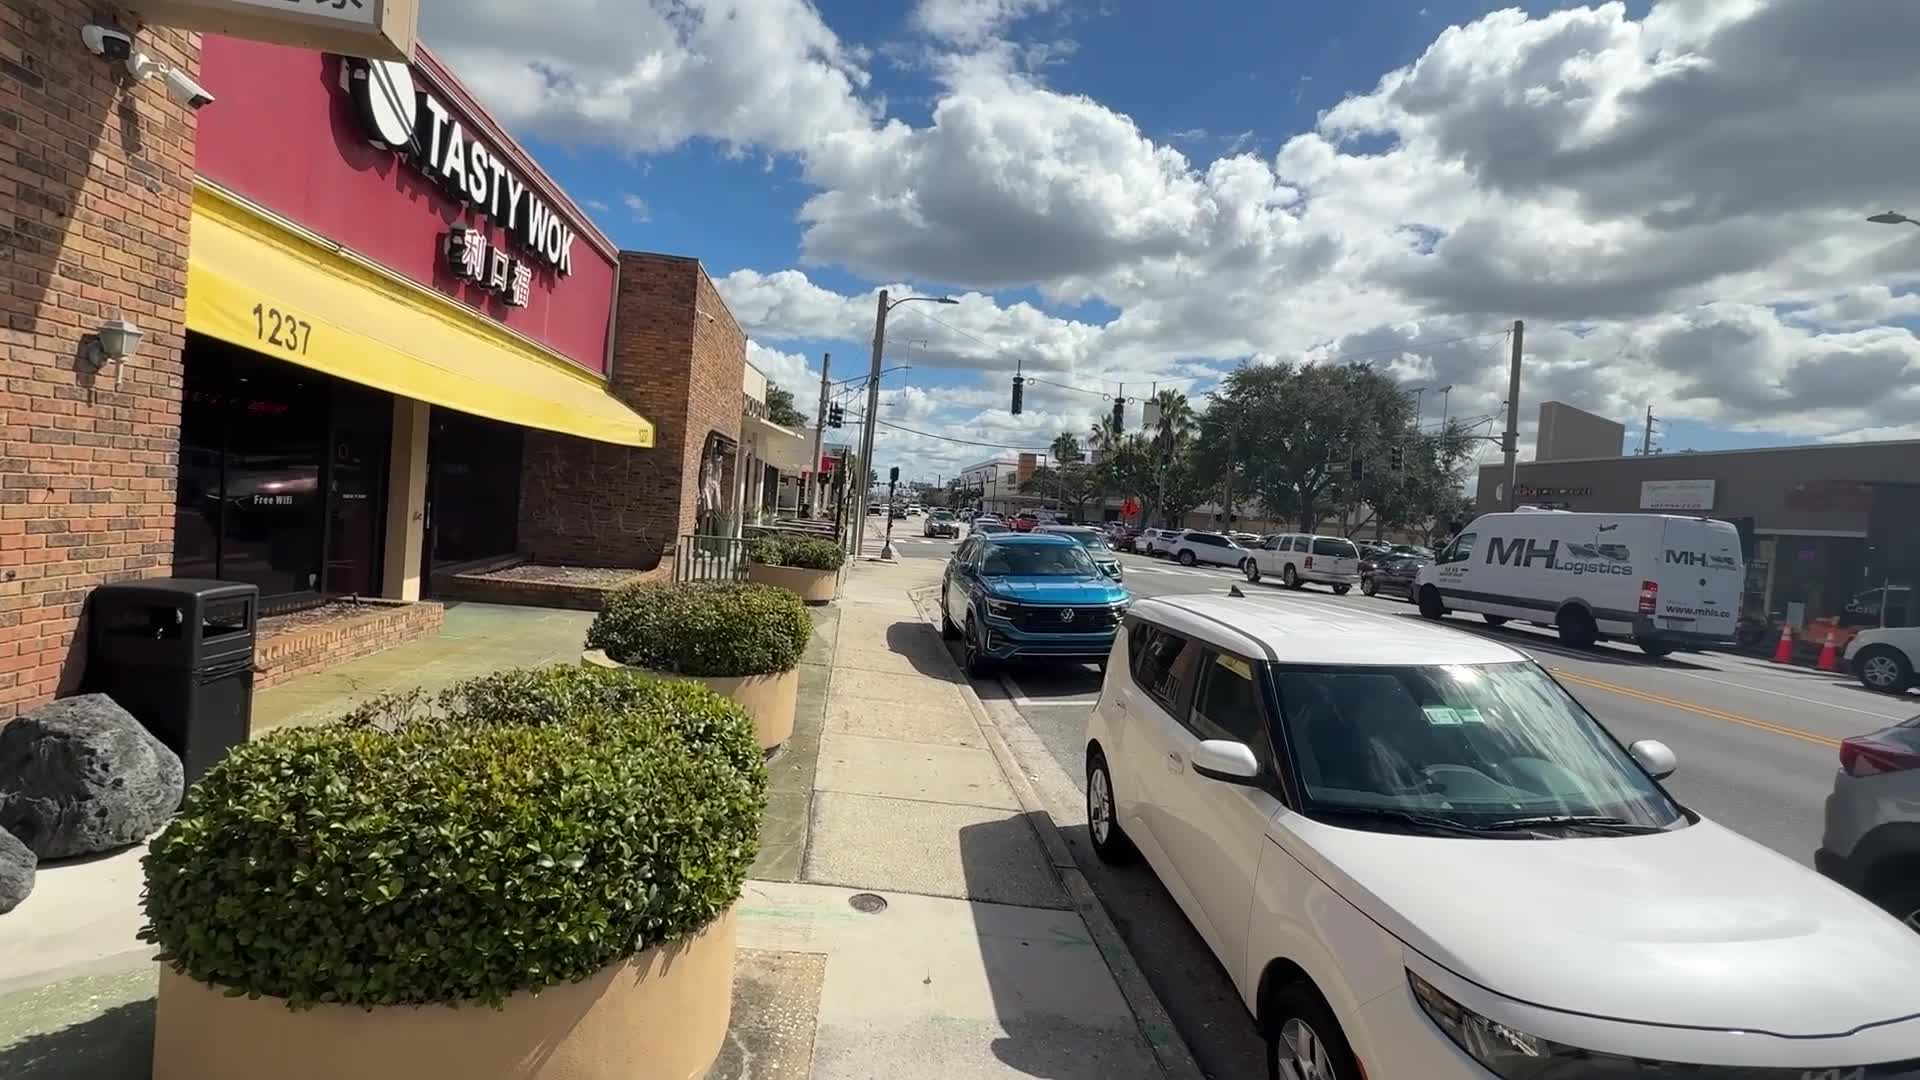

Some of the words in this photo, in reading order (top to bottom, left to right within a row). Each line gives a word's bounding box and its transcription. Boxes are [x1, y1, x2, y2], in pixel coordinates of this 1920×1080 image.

[426, 93, 524, 230] TASTY
[528, 191, 576, 277] WOK
[461, 228, 531, 308] 利口福
[253, 303, 311, 355] 1237
[254, 494, 274, 505] Free
[1486, 536, 1559, 569] MH
[1555, 559, 1633, 576] Logistics
[1665, 549, 1706, 567] MH
